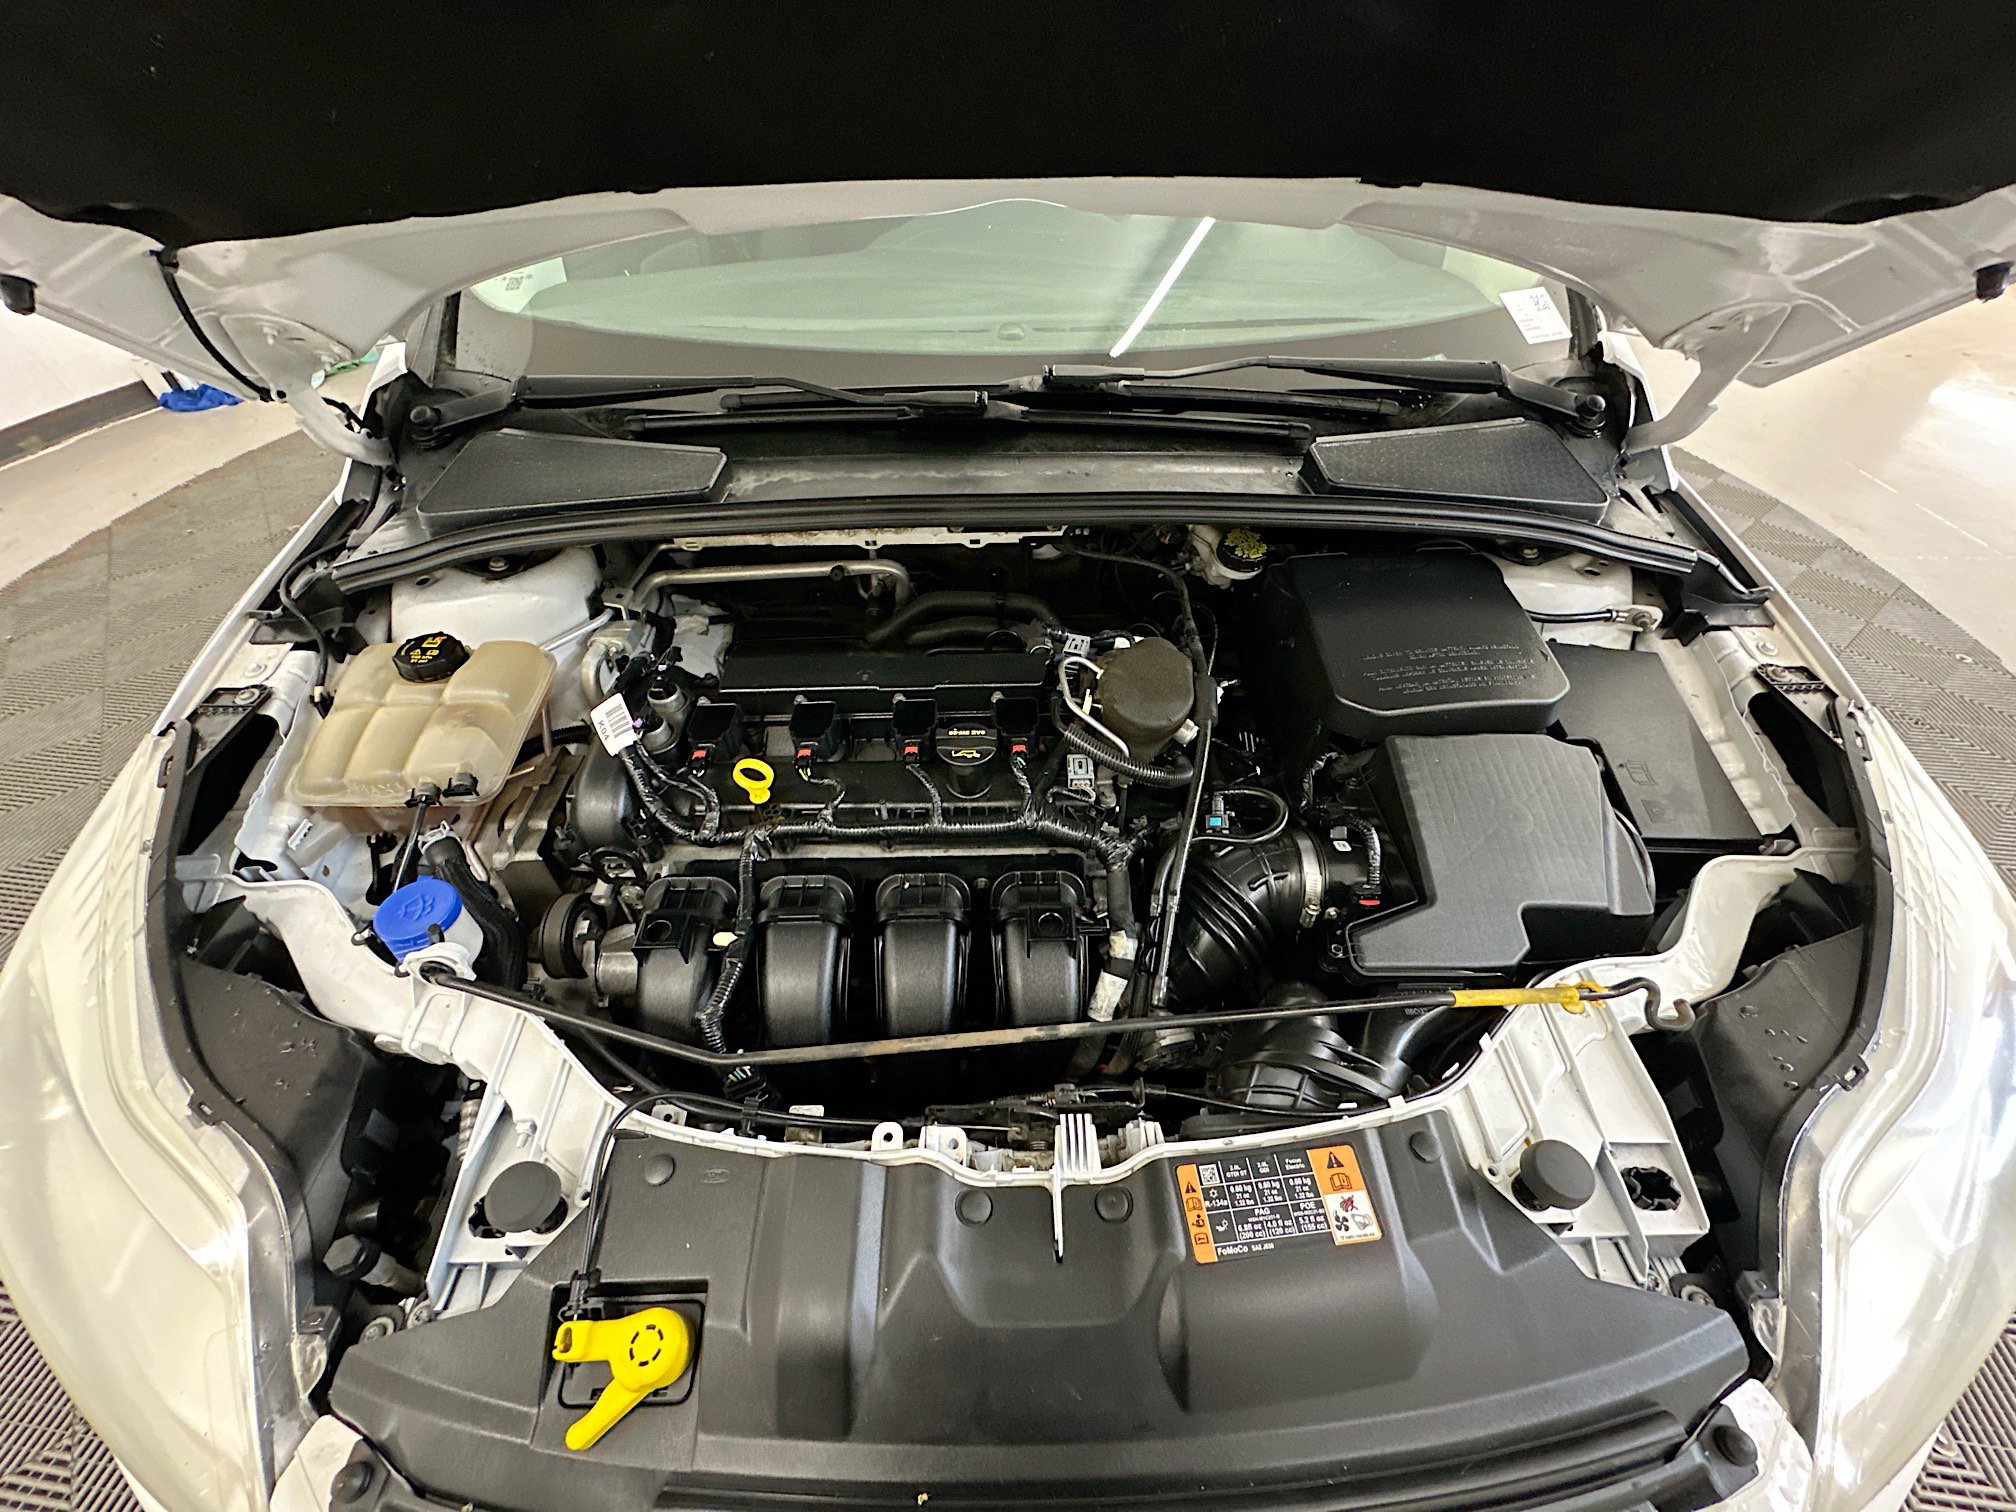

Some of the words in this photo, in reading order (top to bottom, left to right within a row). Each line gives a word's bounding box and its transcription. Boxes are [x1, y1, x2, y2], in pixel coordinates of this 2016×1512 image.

[1272, 1180, 1280, 1189] kg
[1245, 1185, 1252, 1193] kg
[1205, 1199, 1228, 1207] R-134a
[1300, 1202, 1316, 1210] POE
[1254, 1208, 1270, 1216] PAG
[1239, 1231, 1254, 1240] (200
[1255, 1230, 1265, 1239] cc)
[1285, 1227, 1296, 1235] cc)
[1217, 1245, 1248, 1256] FoMoCo
